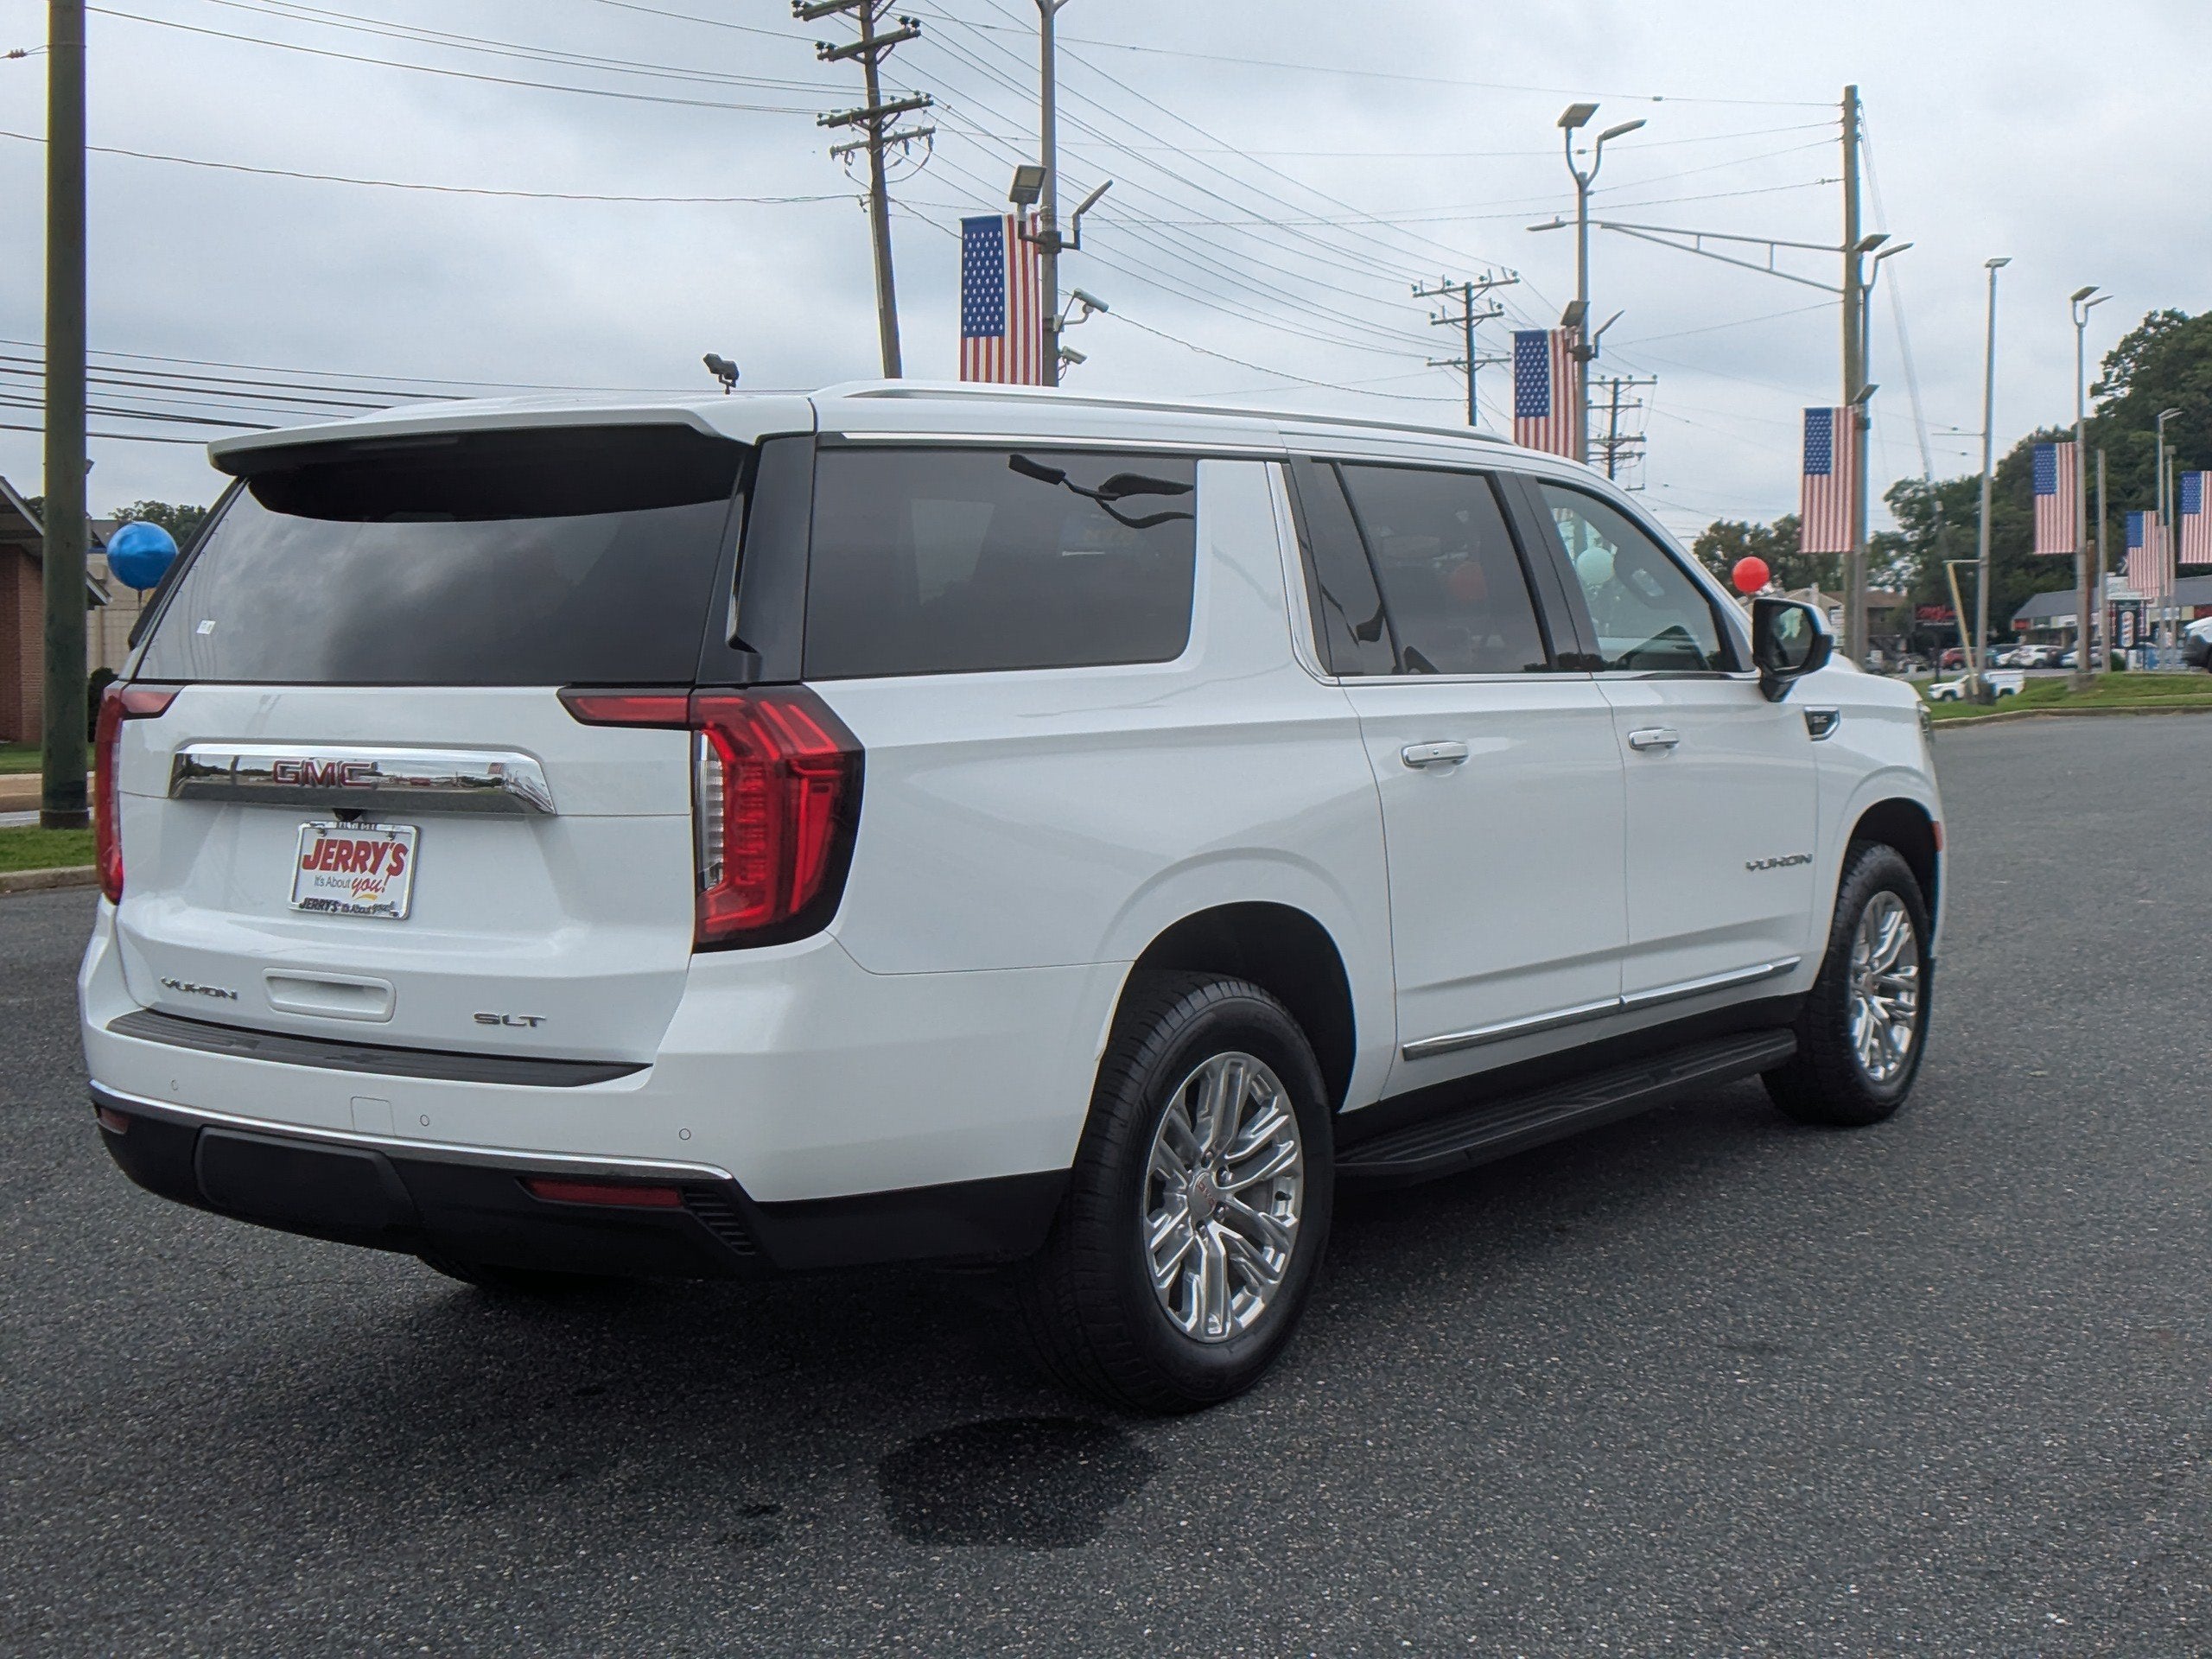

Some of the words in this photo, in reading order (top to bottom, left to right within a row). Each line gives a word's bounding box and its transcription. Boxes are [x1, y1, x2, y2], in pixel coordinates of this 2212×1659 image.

[273, 760, 375, 787] GMC
[302, 838, 409, 876] JERRY'S
[1745, 854, 1813, 871] YUKON
[315, 874, 325, 887] It's
[326, 875, 351, 888] About
[160, 976, 238, 1000] YUKON
[474, 1012, 546, 1027] SLT
